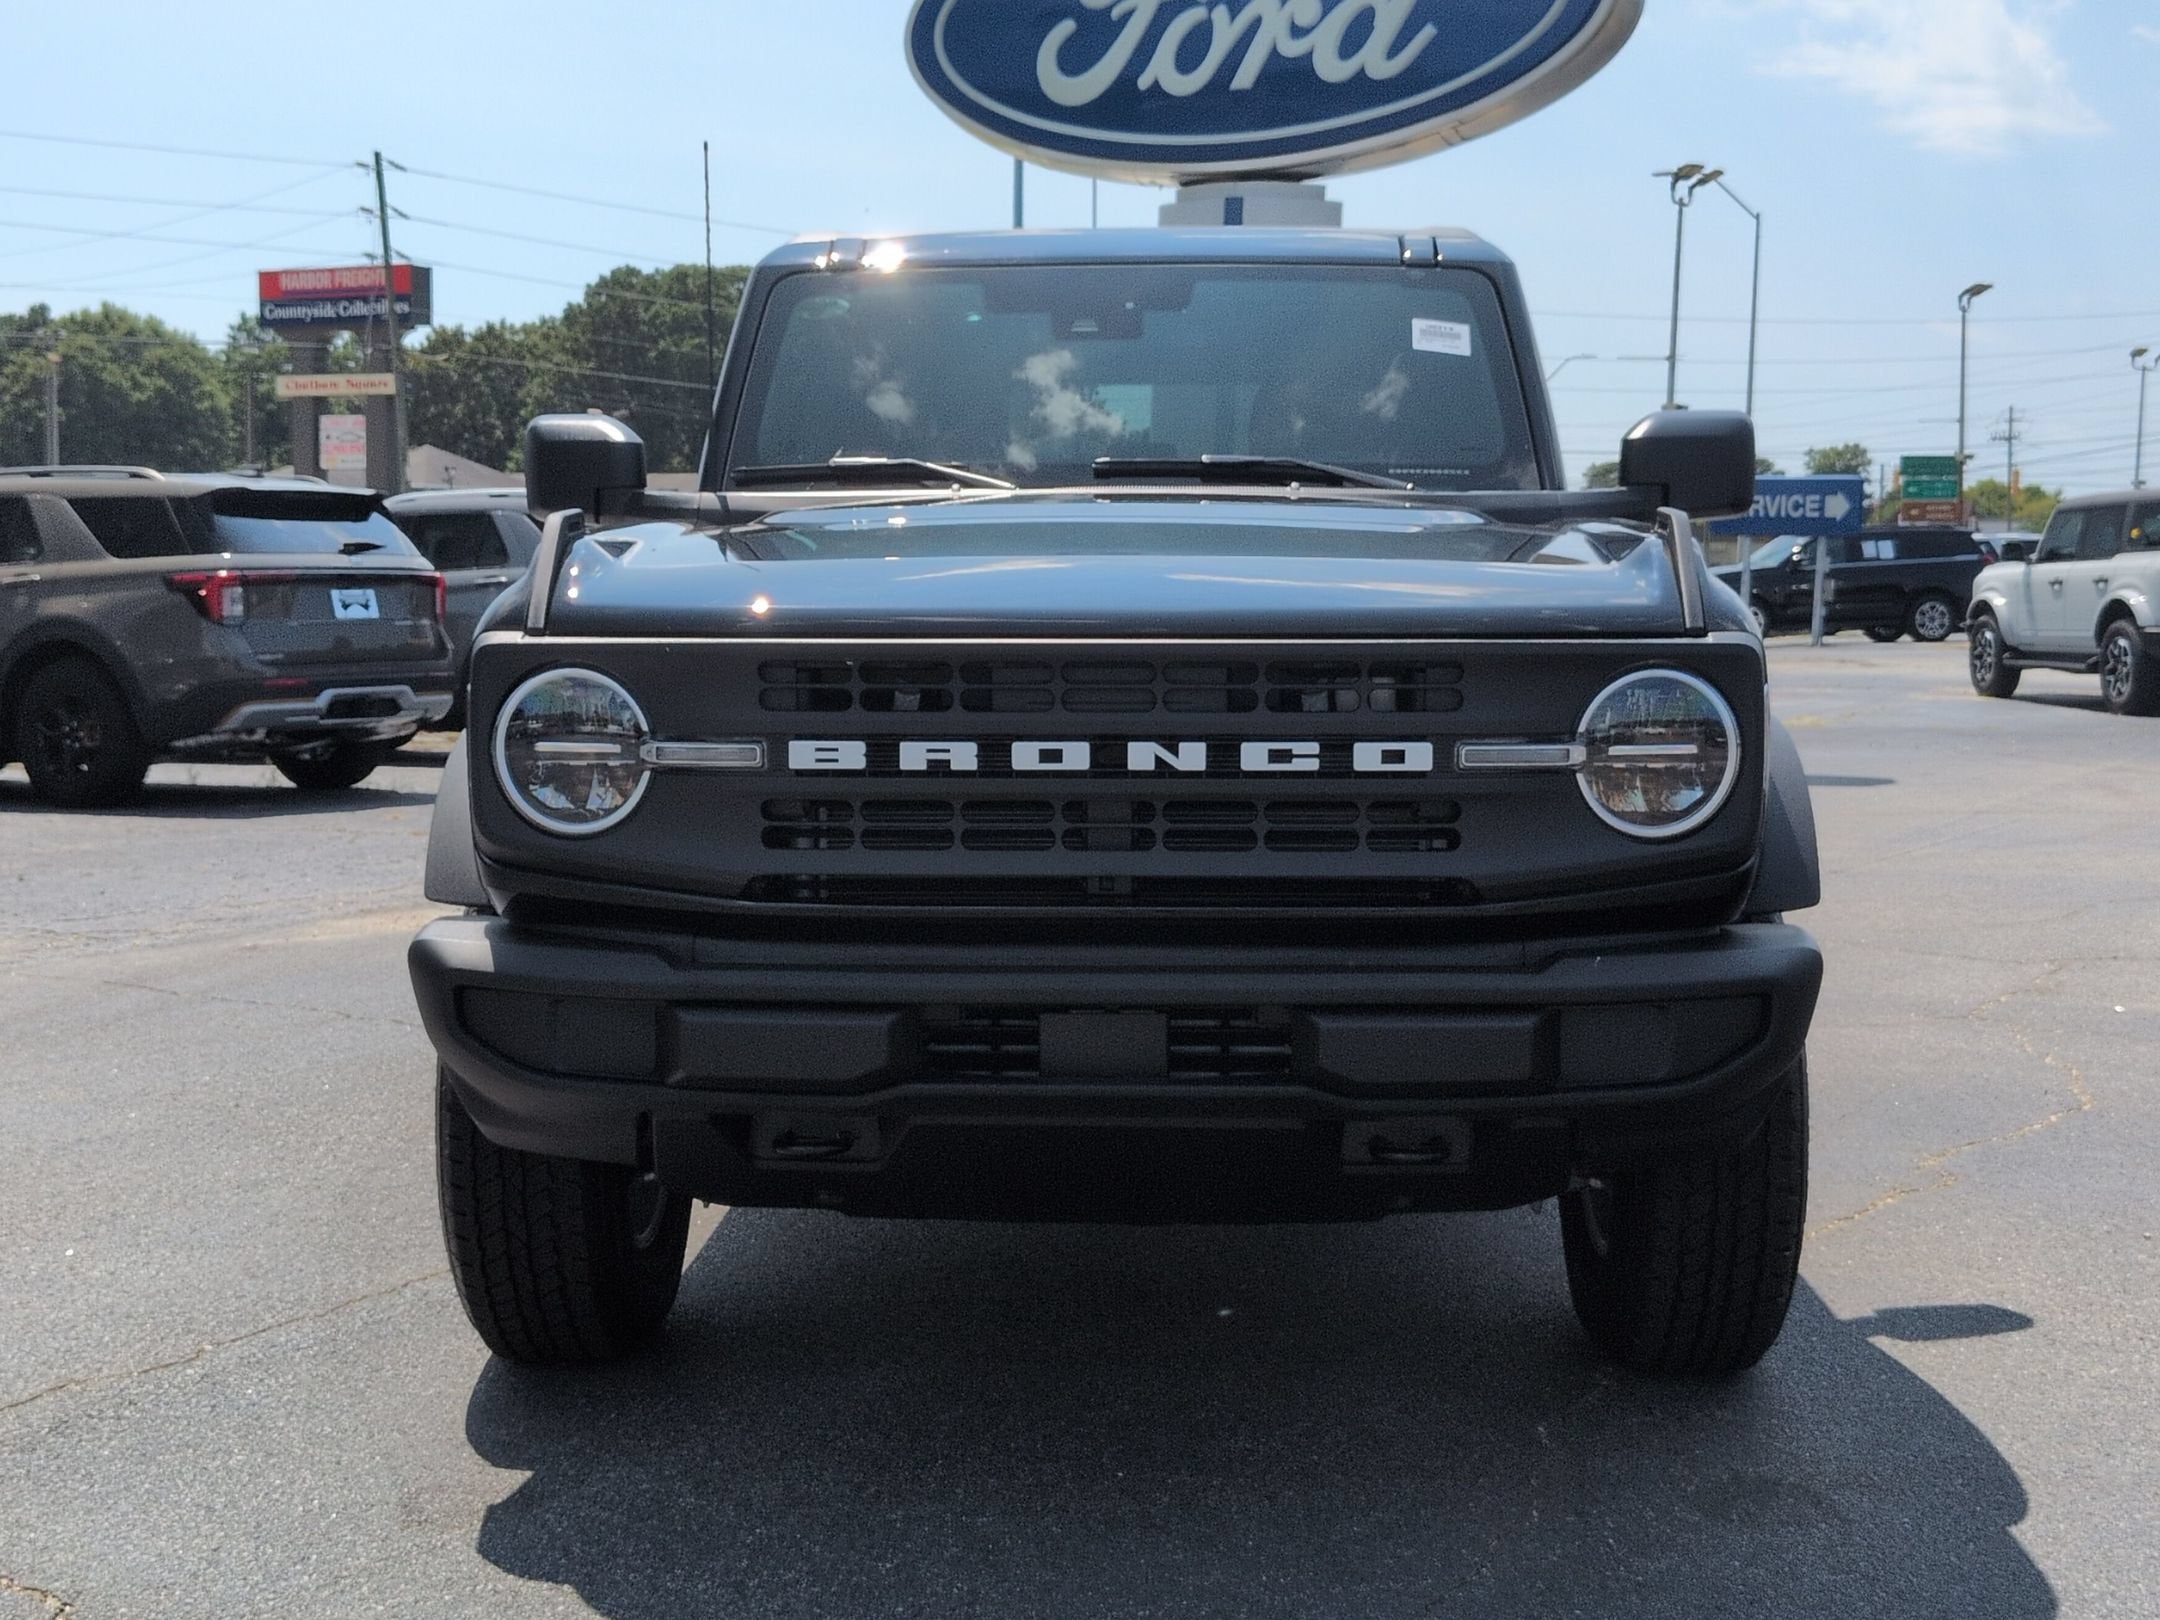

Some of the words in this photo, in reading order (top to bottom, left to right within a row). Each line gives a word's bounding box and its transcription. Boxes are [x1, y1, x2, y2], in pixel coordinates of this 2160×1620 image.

[1036, 0, 1437, 106] Ford
[280, 271, 331, 291] HARBOR
[336, 267, 387, 288] FREIGH
[264, 303, 337, 322] Countryside
[338, 299, 410, 317] Collecties
[1747, 494, 1820, 518] RVICE
[788, 741, 1434, 771] BRONCO
